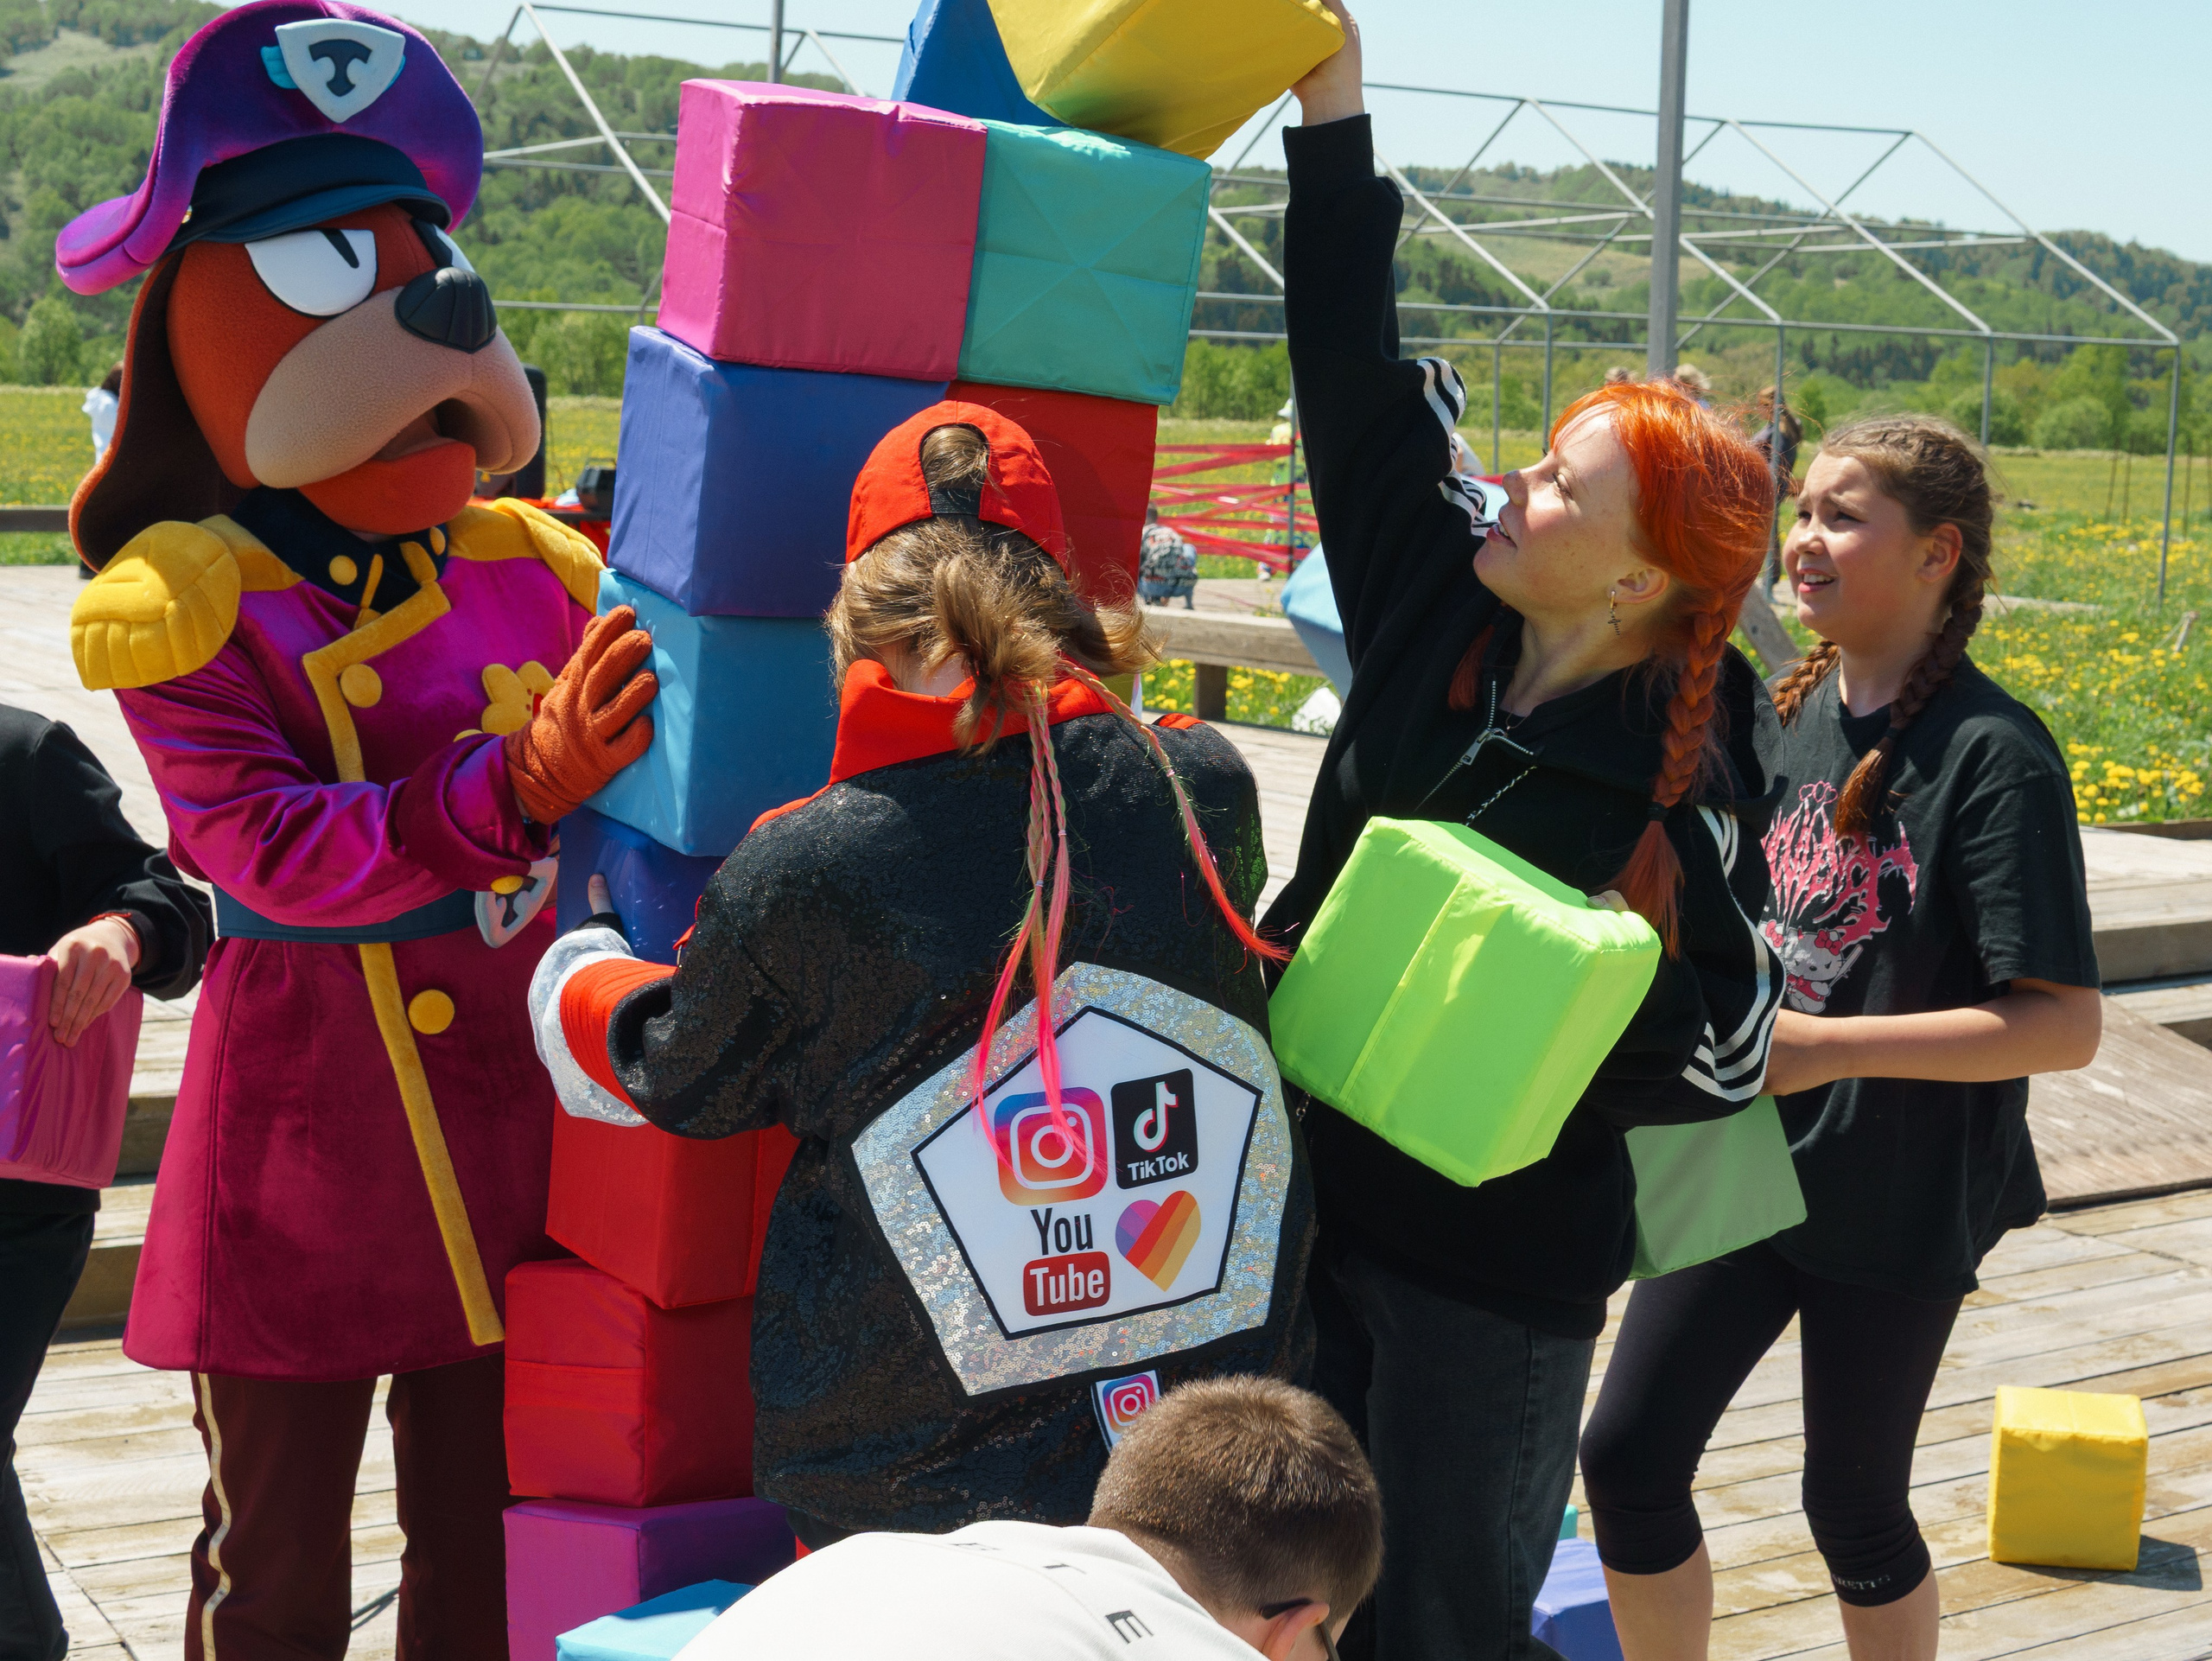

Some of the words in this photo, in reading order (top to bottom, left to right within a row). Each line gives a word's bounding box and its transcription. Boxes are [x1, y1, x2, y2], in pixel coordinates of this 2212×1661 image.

[1127, 1152, 1190, 1181] TikTok
[1030, 1207, 1093, 1256] You
[1029, 1263, 1104, 1307] Tube
